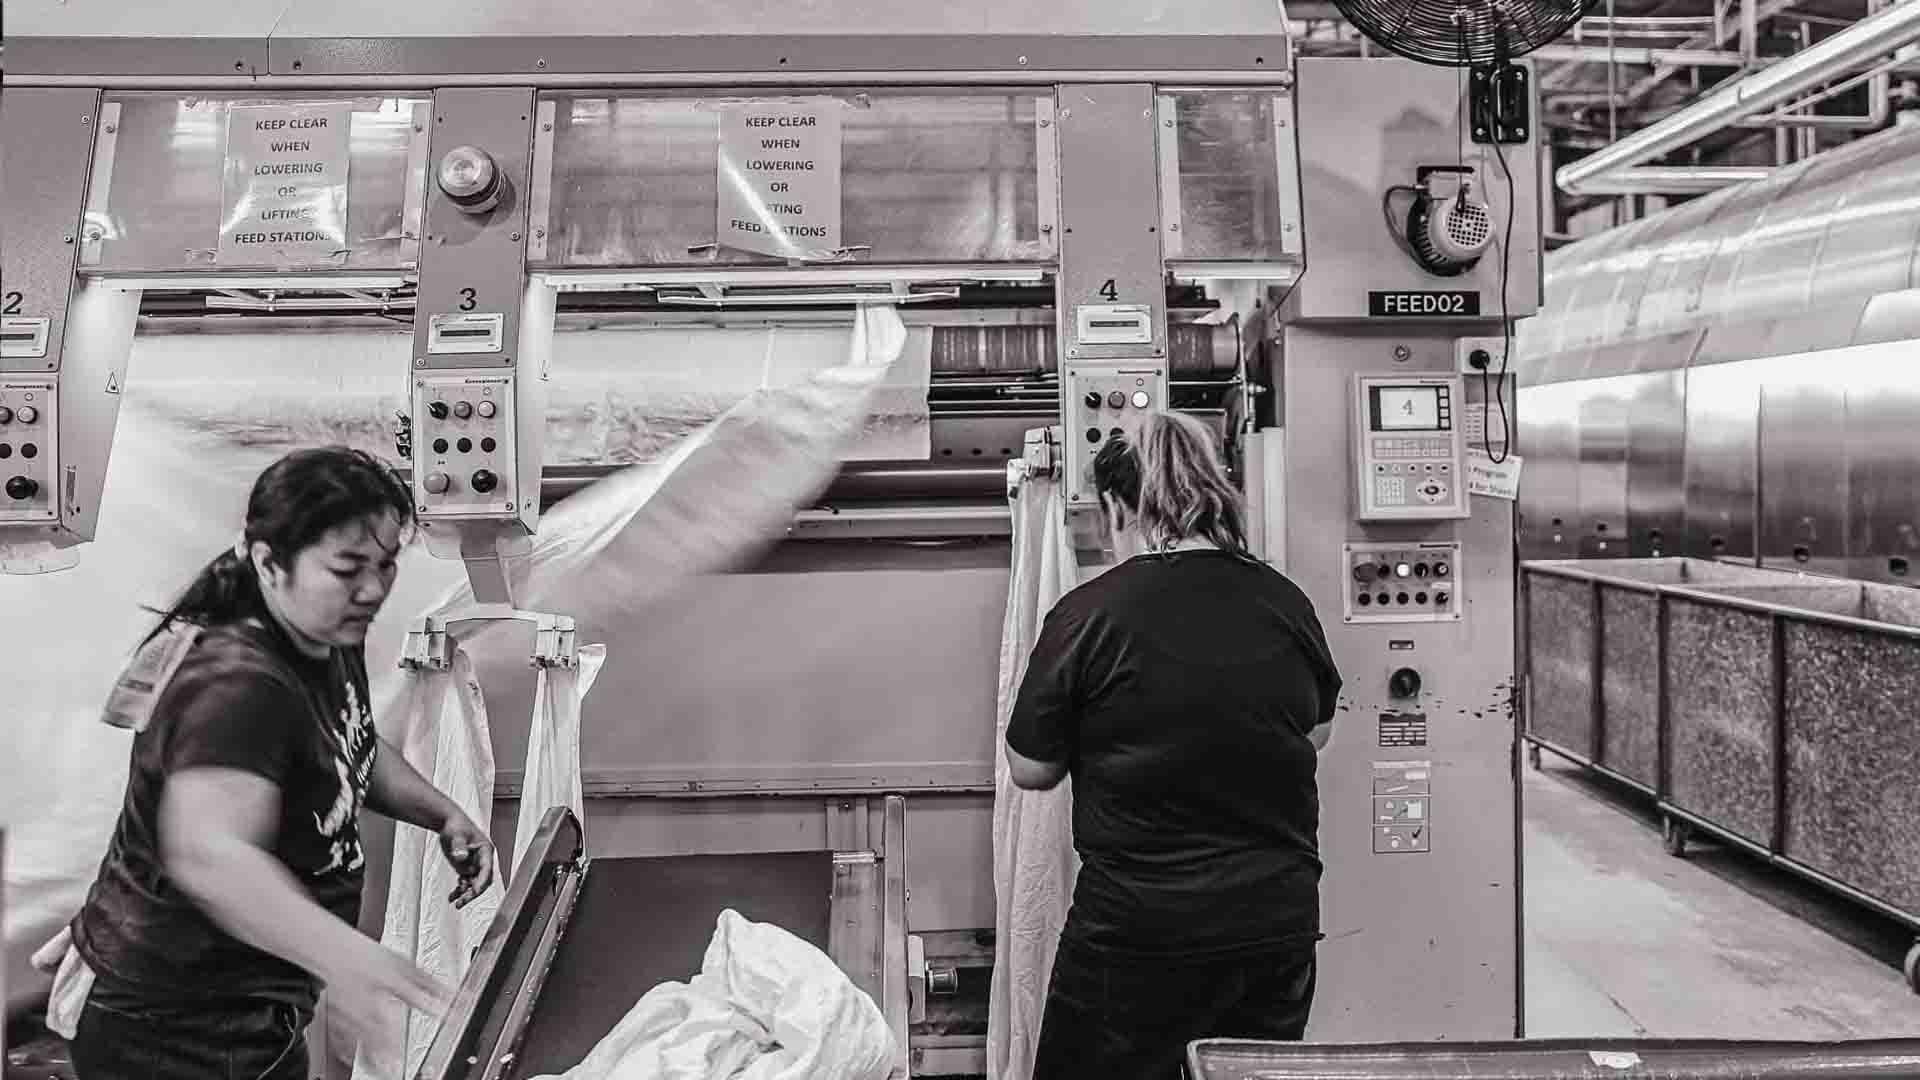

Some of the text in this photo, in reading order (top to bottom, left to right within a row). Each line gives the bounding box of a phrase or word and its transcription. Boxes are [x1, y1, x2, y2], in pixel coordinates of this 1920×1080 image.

[255, 117, 328, 131] KEEP CLEAR
[745, 116, 817, 128] KEEP CLEAR
[270, 140, 310, 153] WHEN
[761, 138, 801, 149] WHEN
[254, 161, 324, 176] LOWERING
[746, 159, 815, 171] LOWERING
[278, 185, 297, 198] OR
[770, 182, 789, 193] OR
[730, 219, 762, 233] FEED
[234, 230, 332, 244] FEED STATION
[1099, 279, 1119, 301] 4
[2, 291, 24, 315] 2
[459, 287, 477, 311] 3
[1383, 294, 1465, 313] FEED02
